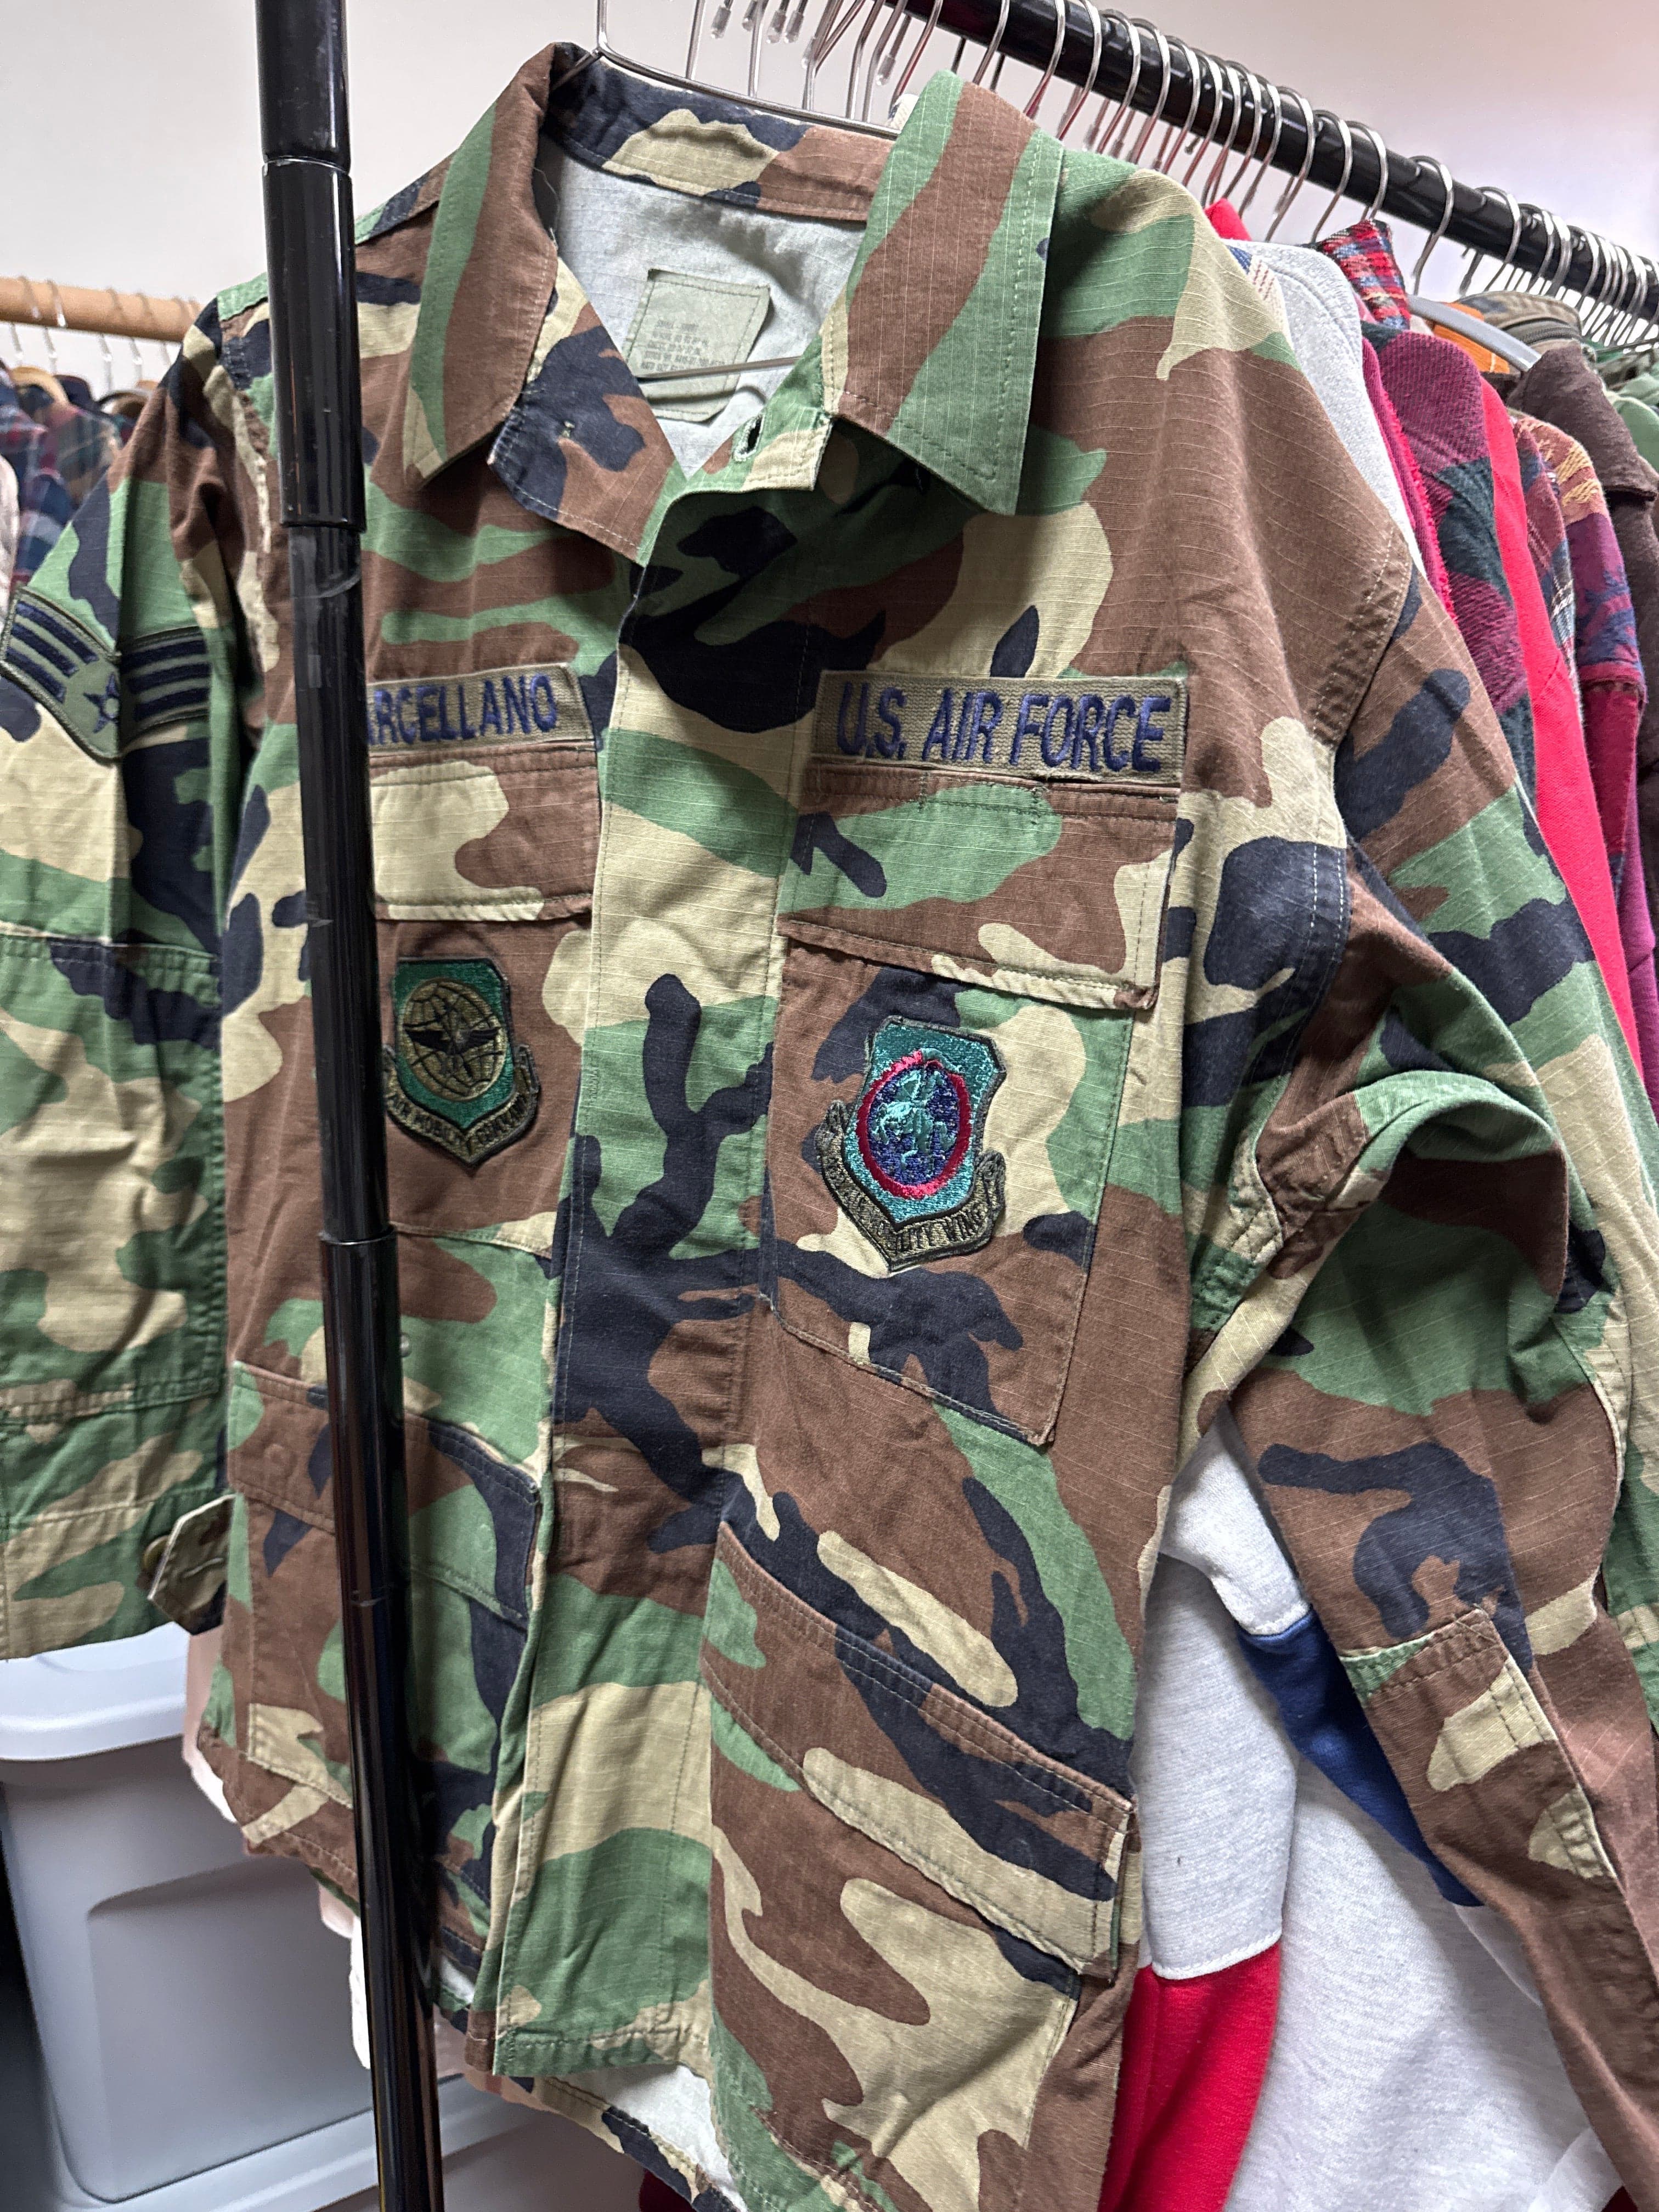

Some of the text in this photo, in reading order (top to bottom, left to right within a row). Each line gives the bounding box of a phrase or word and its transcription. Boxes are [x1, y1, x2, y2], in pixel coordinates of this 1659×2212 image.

[837, 681, 1171, 772] U.S. AIR FORCE
